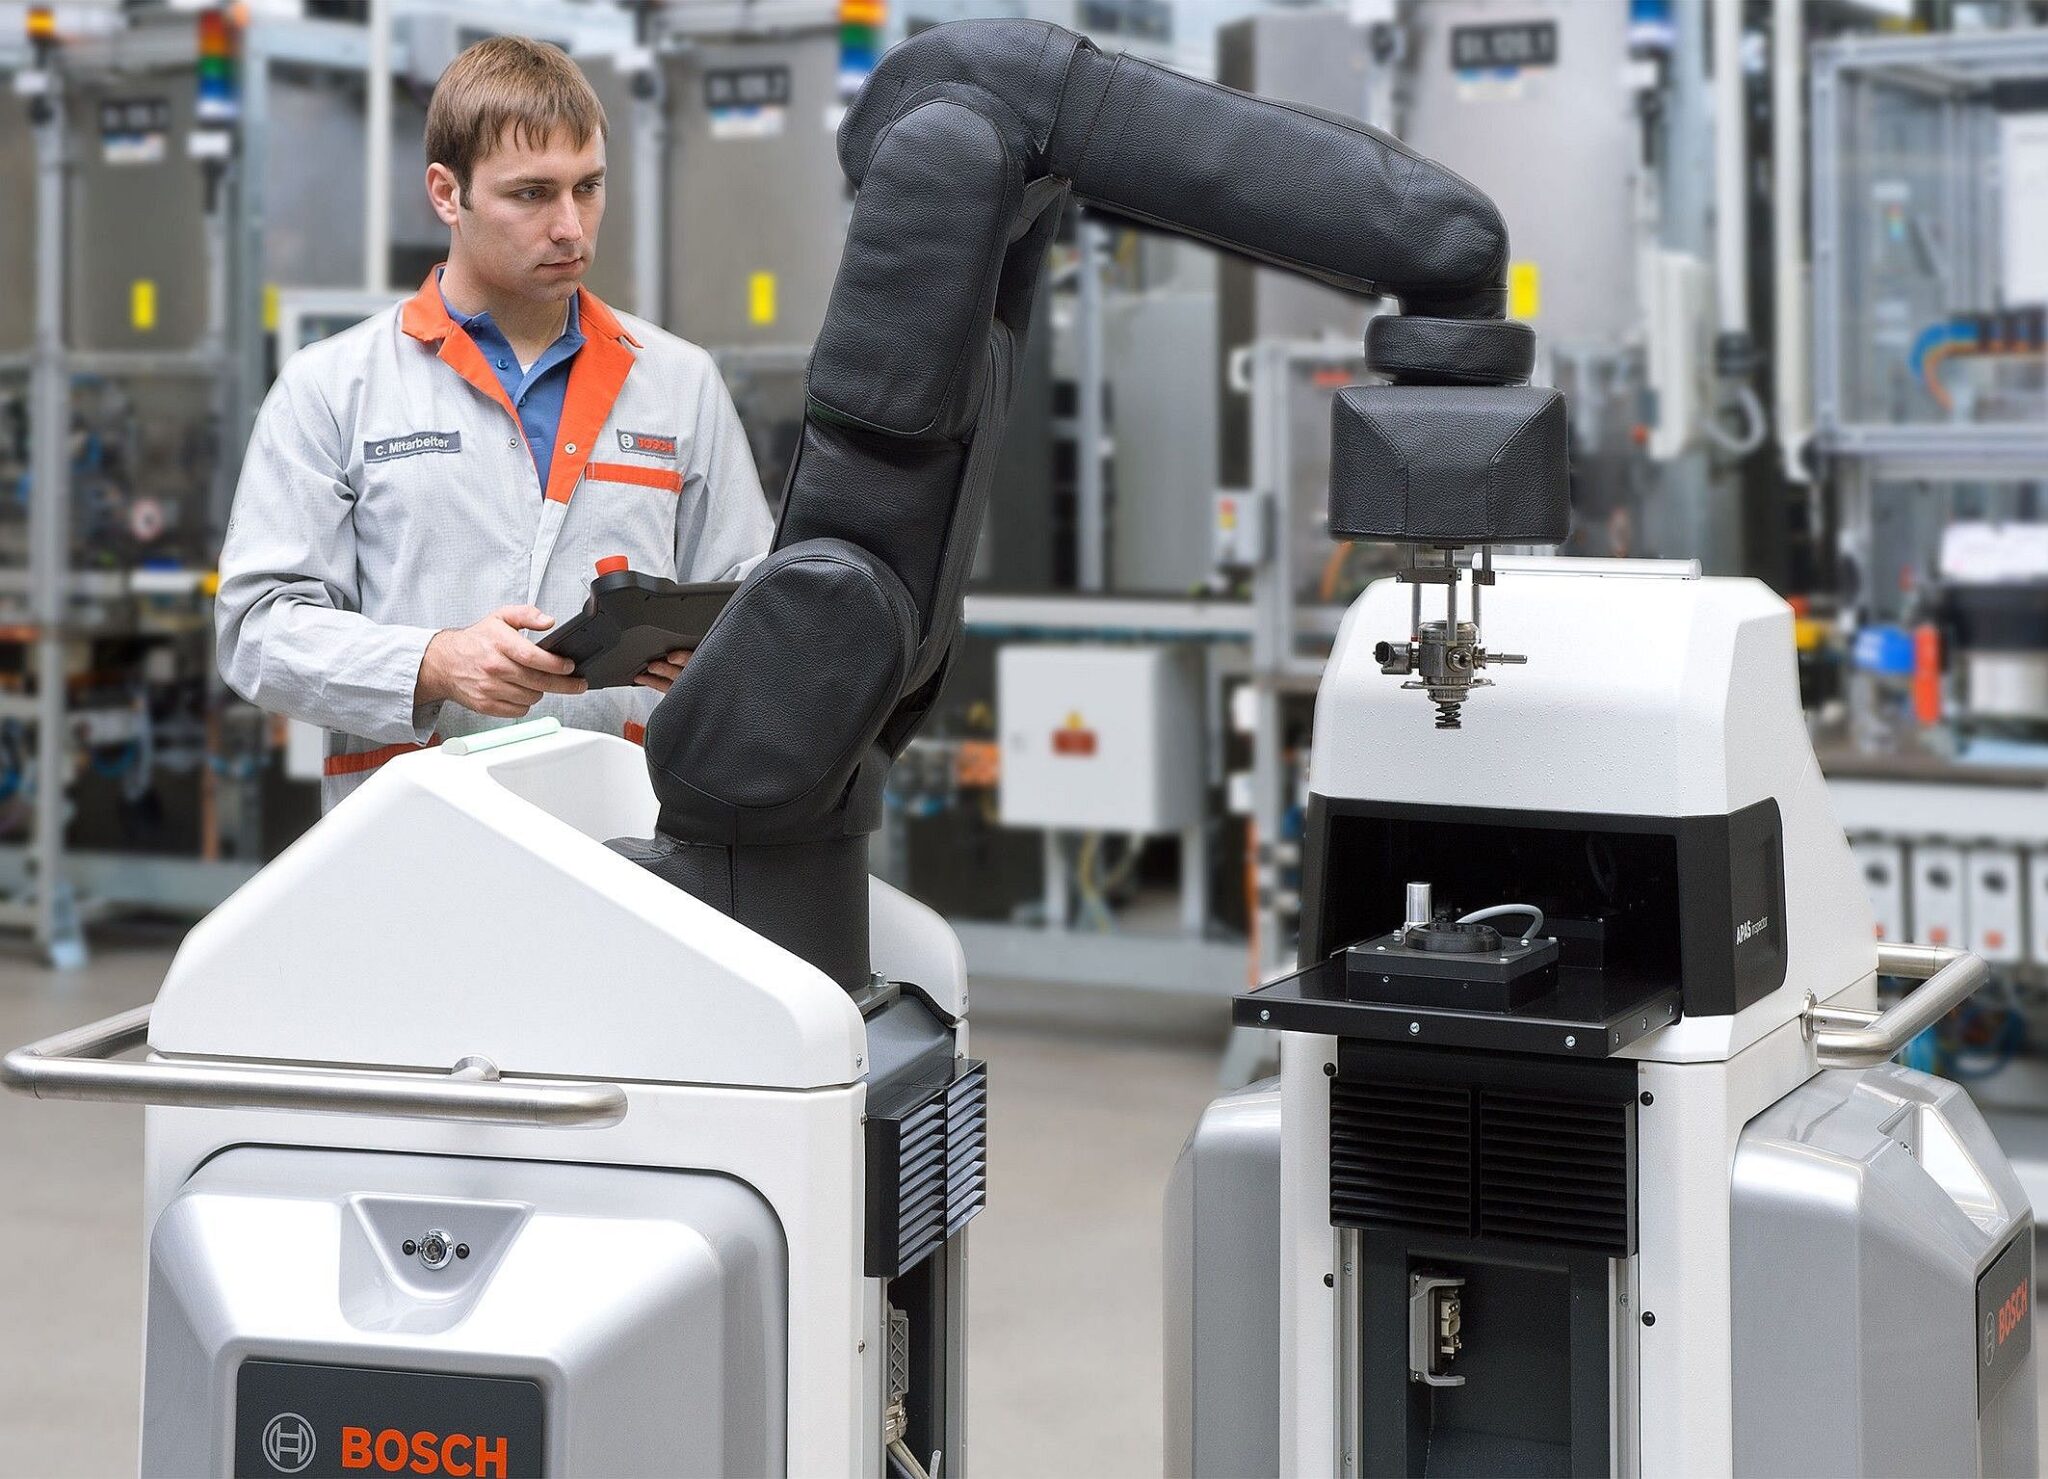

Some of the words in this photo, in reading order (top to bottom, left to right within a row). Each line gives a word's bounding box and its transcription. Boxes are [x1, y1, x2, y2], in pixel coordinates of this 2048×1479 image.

[375, 445, 387, 456] C.
[389, 436, 449, 454] Mitarbeiter
[636, 436, 674, 452] BOSCH
[1736, 920, 1751, 945] APAS
[1998, 1277, 2028, 1345] BOSCH
[341, 1426, 508, 1479] BOSCH
